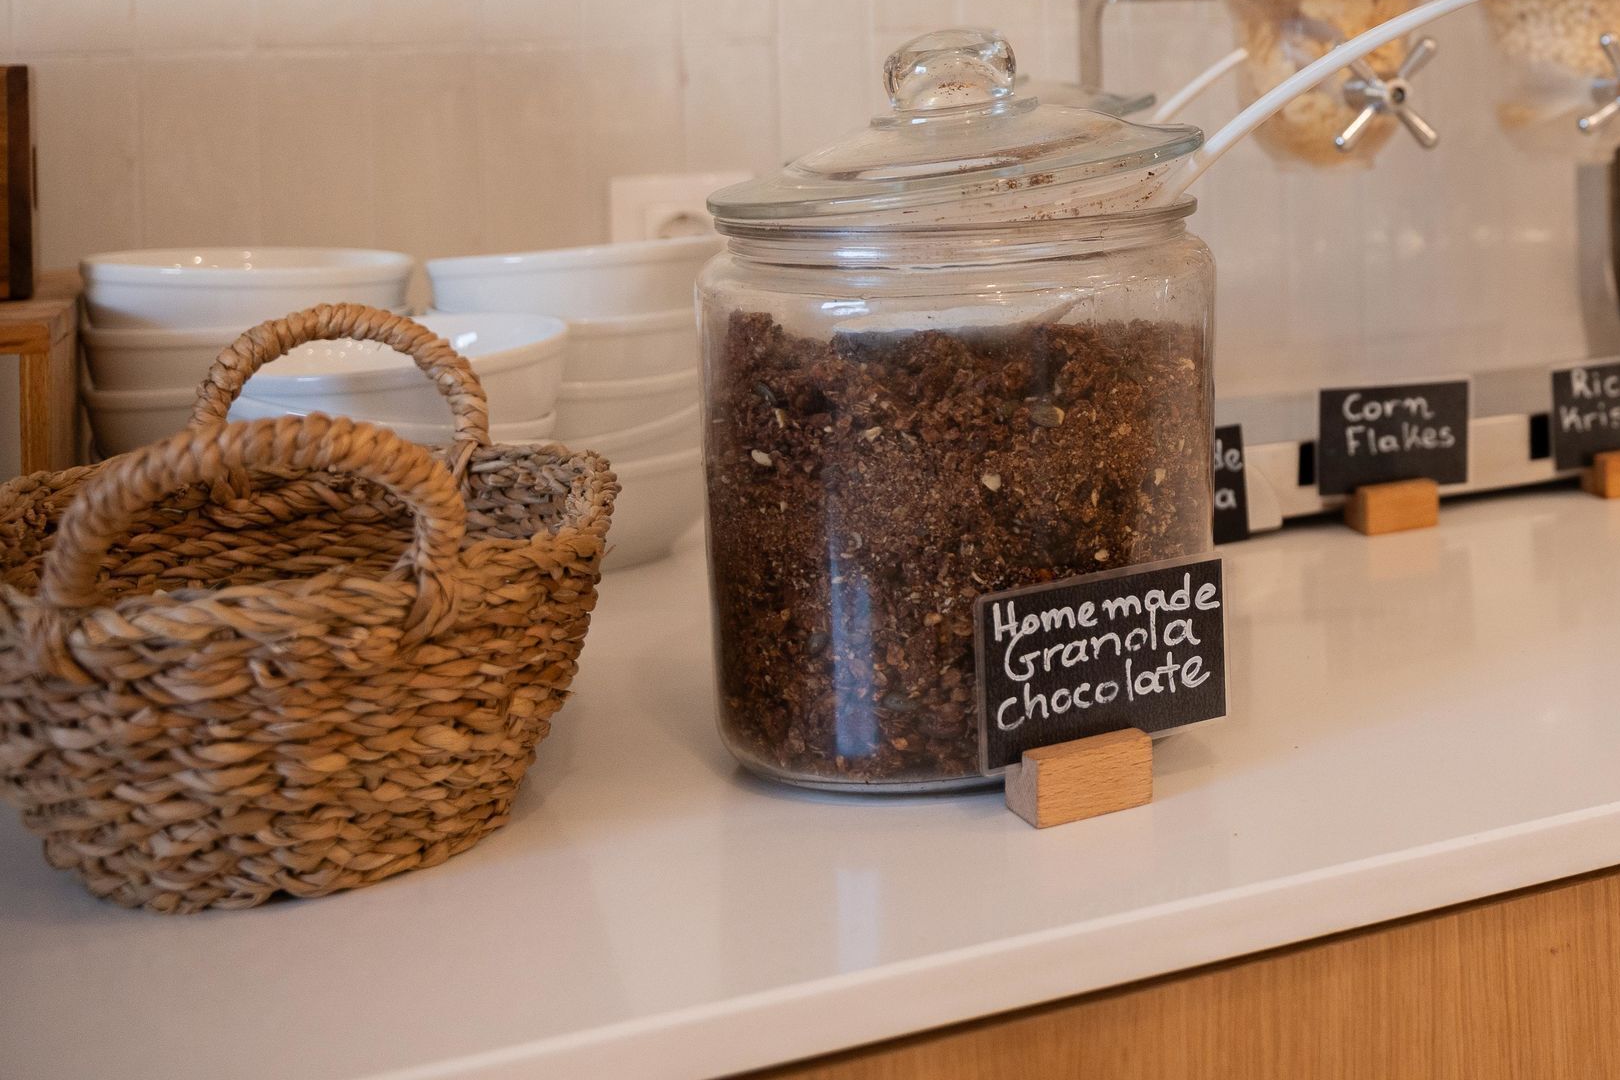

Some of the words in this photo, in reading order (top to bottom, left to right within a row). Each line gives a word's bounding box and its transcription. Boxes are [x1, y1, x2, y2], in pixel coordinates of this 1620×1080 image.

[1342, 393, 1434, 421] Corn
[1346, 422, 1455, 456] Flakes
[993, 572, 1221, 642] Homemade
[1004, 607, 1201, 682] Granola
